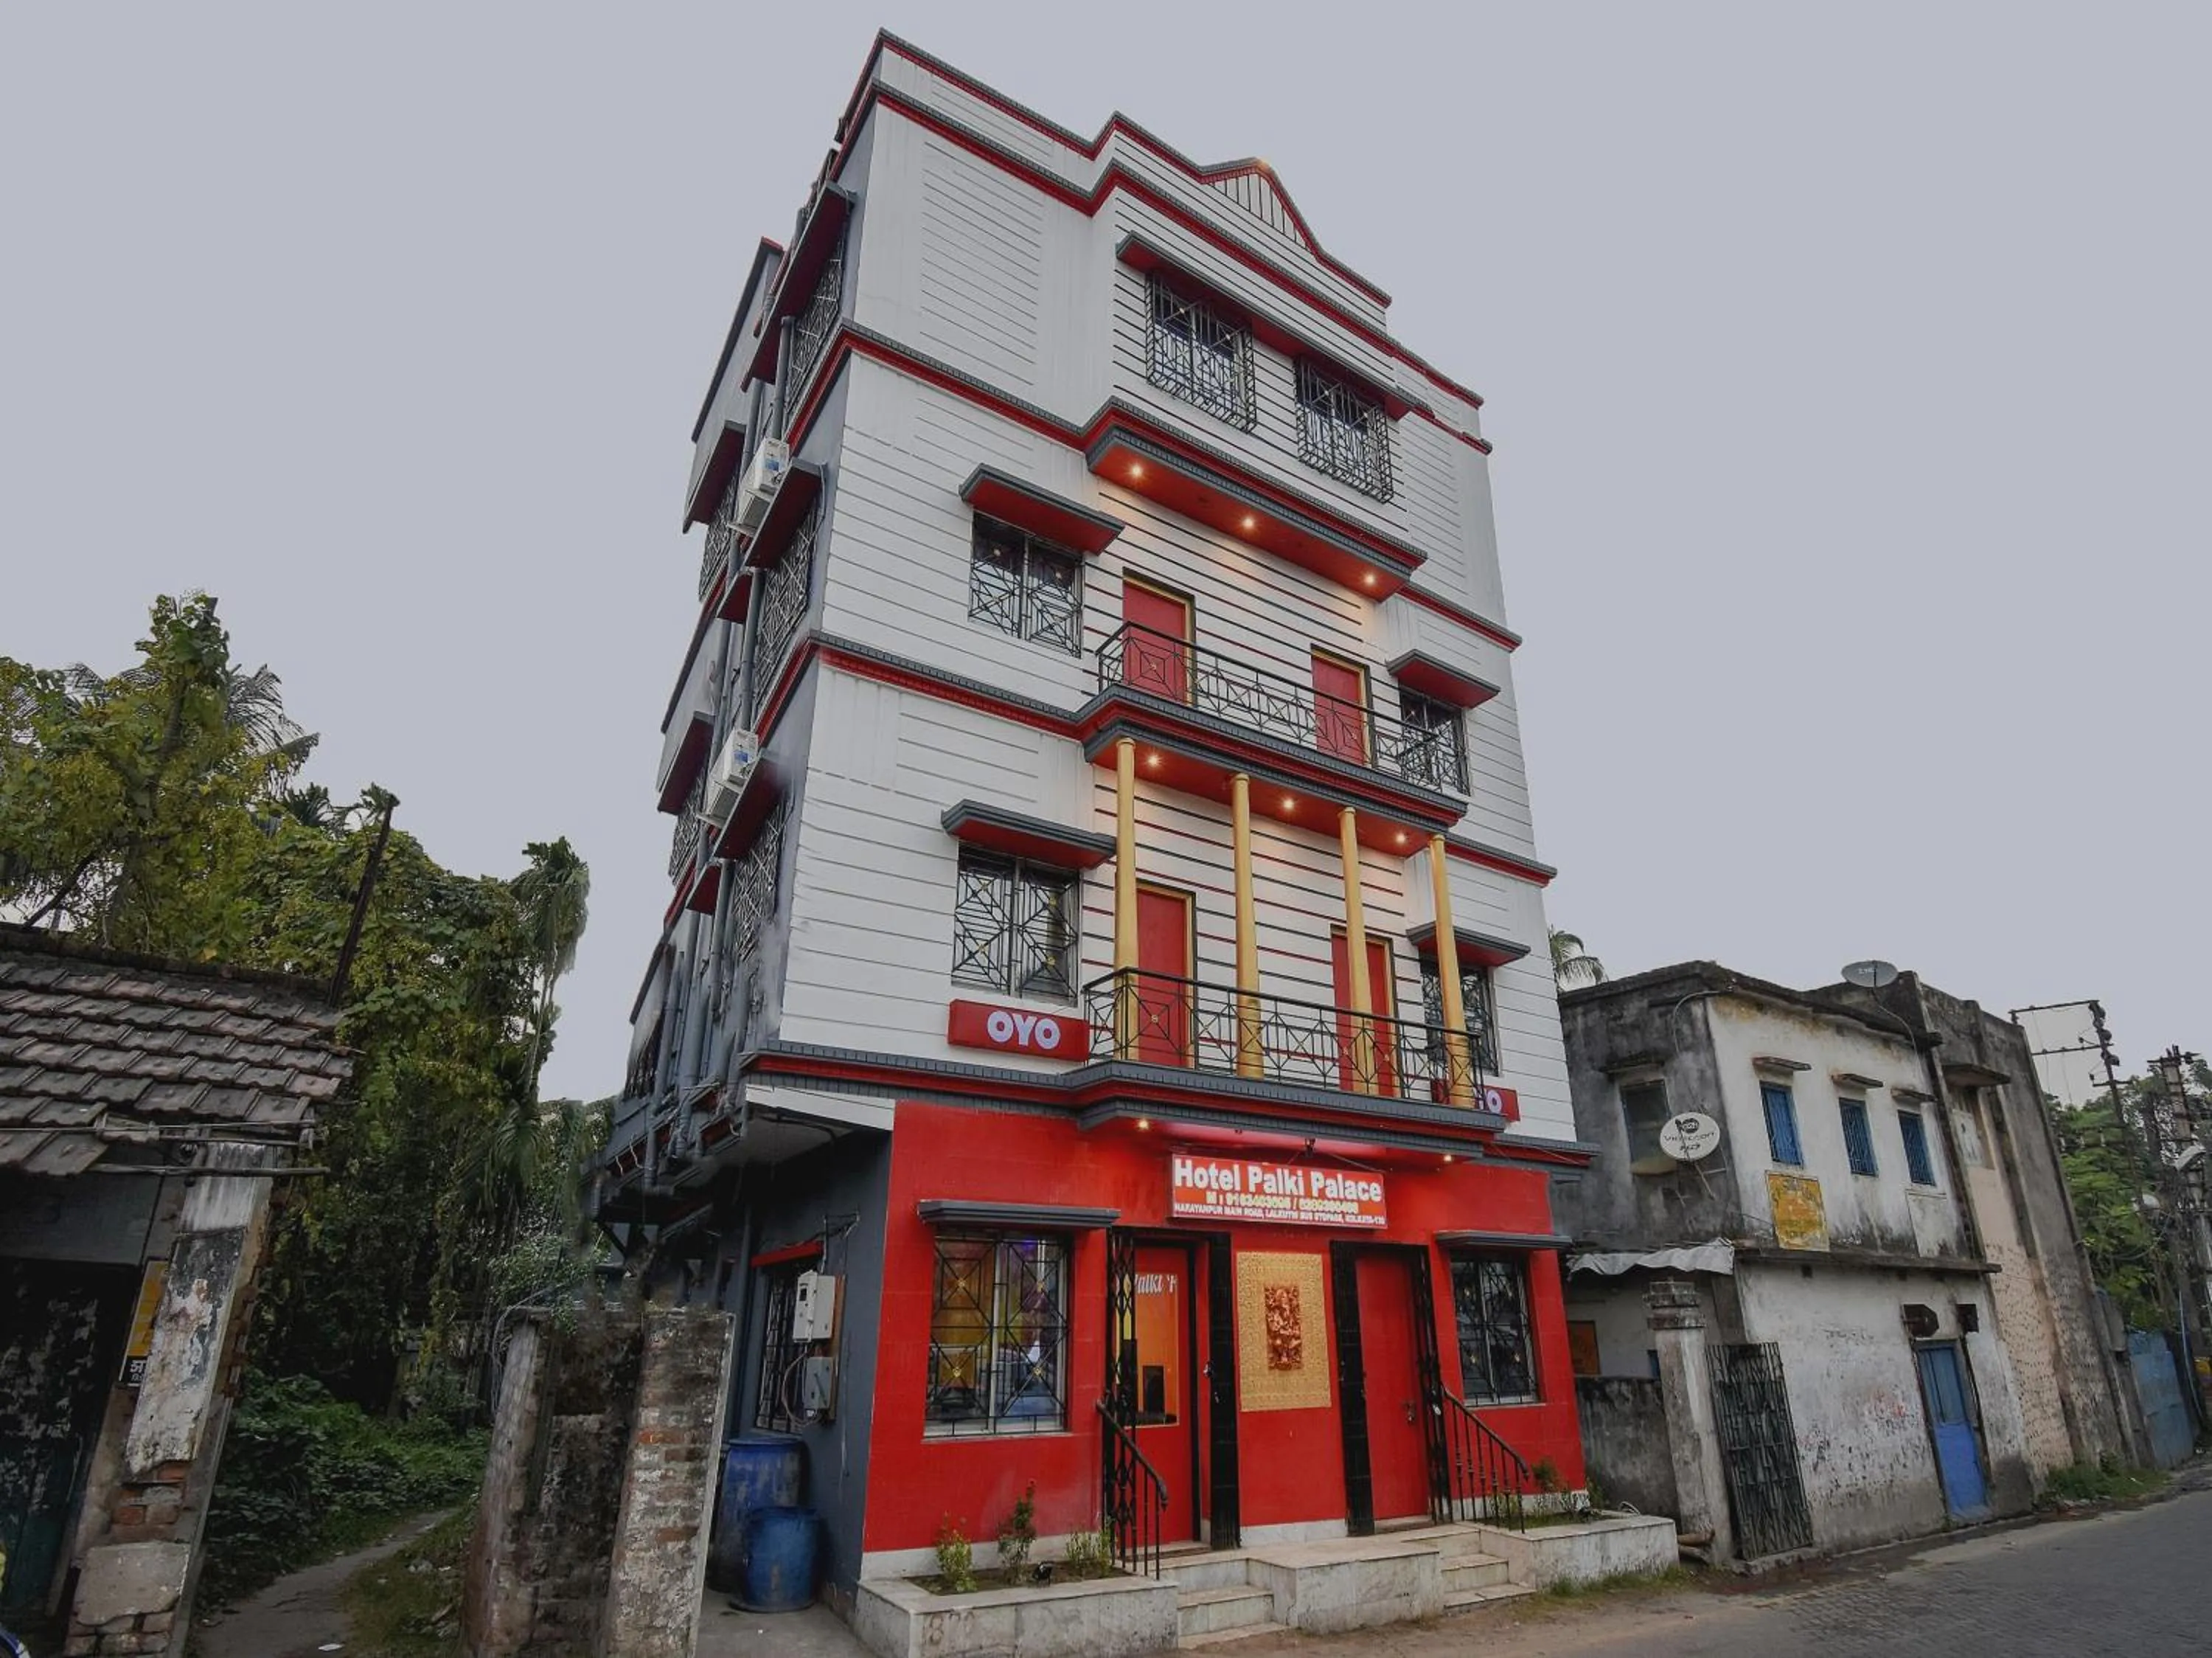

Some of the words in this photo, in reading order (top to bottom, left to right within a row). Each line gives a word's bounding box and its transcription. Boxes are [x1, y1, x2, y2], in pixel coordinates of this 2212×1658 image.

[987, 1010, 1060, 1050] OYO
[1175, 1159, 1241, 1191] Hotel
[1248, 1165, 1304, 1196] Palki
[1311, 1170, 1382, 1202] Palace
